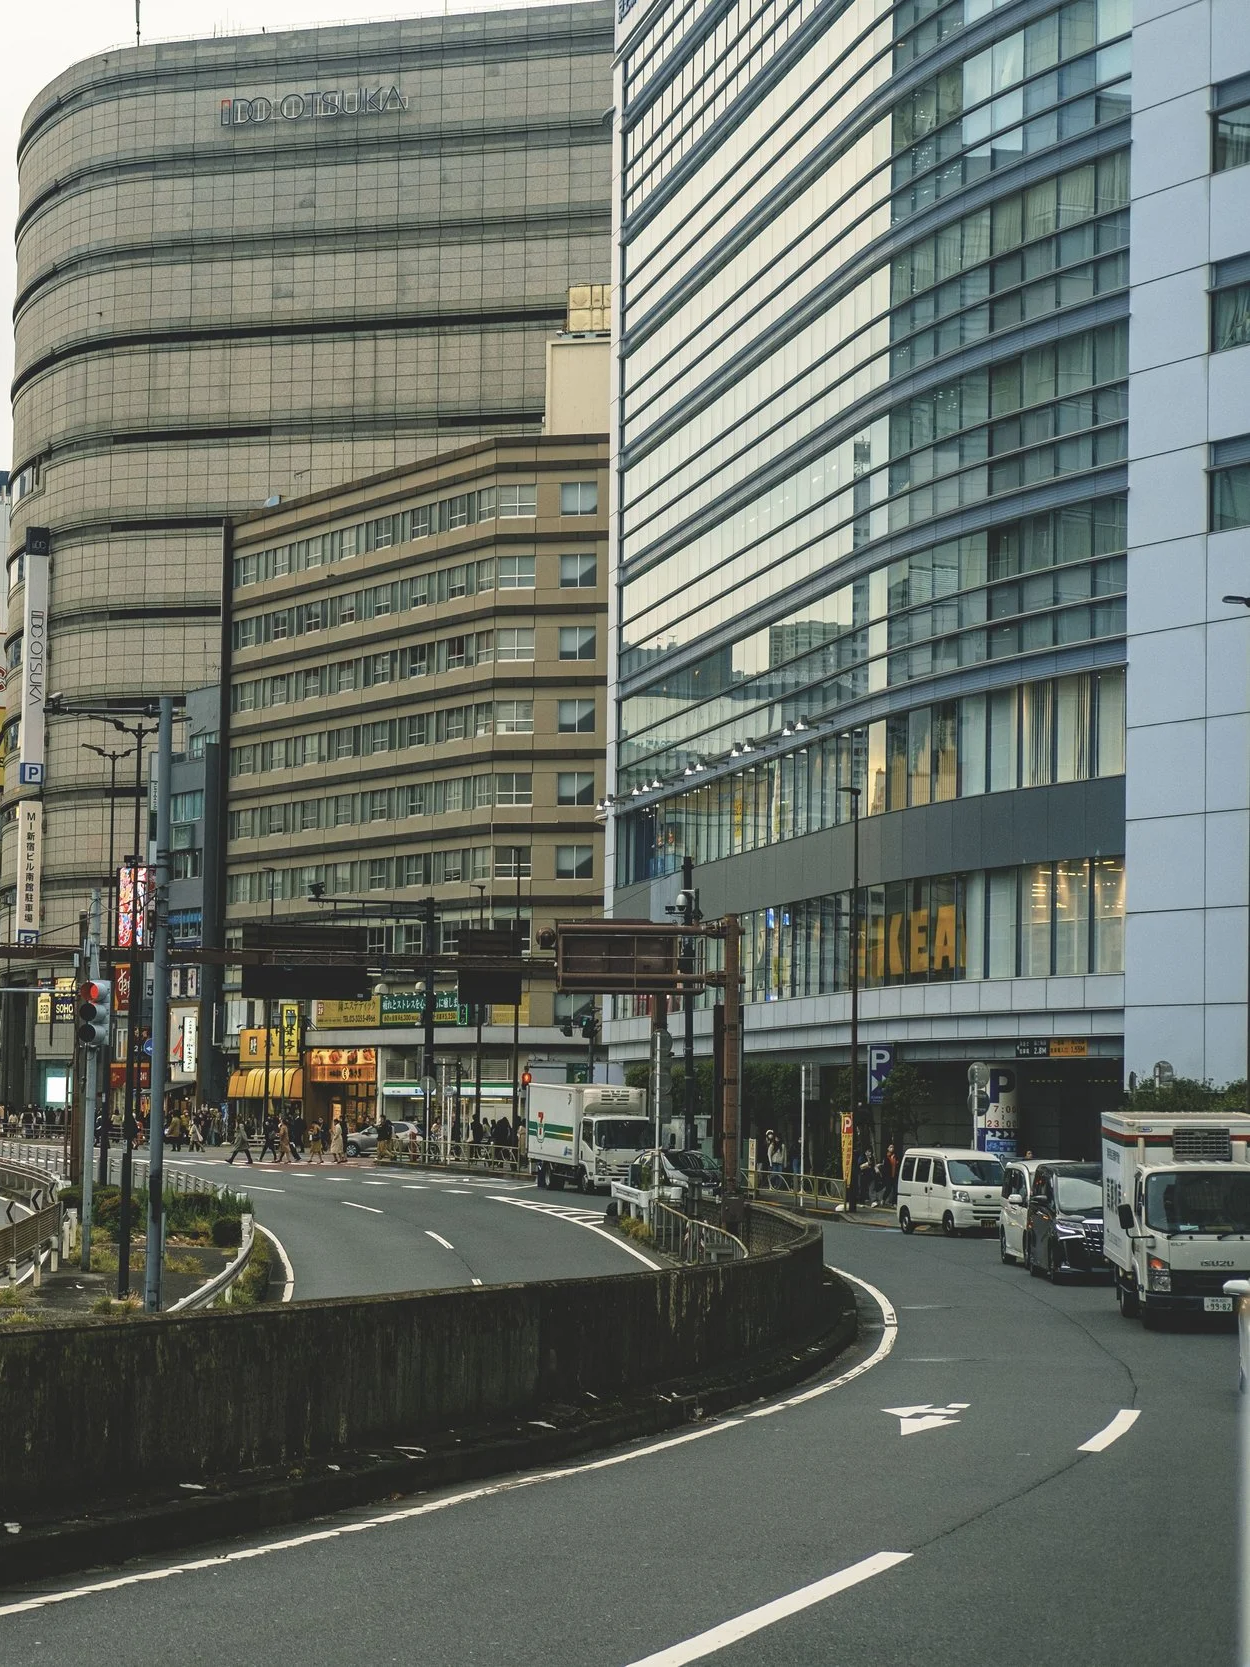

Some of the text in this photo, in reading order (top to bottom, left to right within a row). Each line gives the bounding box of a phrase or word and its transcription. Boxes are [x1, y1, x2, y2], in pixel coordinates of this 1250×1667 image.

[280, 86, 408, 120] OTSUKA
[28, 641, 43, 706] OTSUKA
[29, 766, 39, 780] P
[55, 1004, 74, 1014] SOHO
[871, 1050, 890, 1070] P
[990, 1069, 1016, 1103] P
[844, 1116, 852, 1133] P
